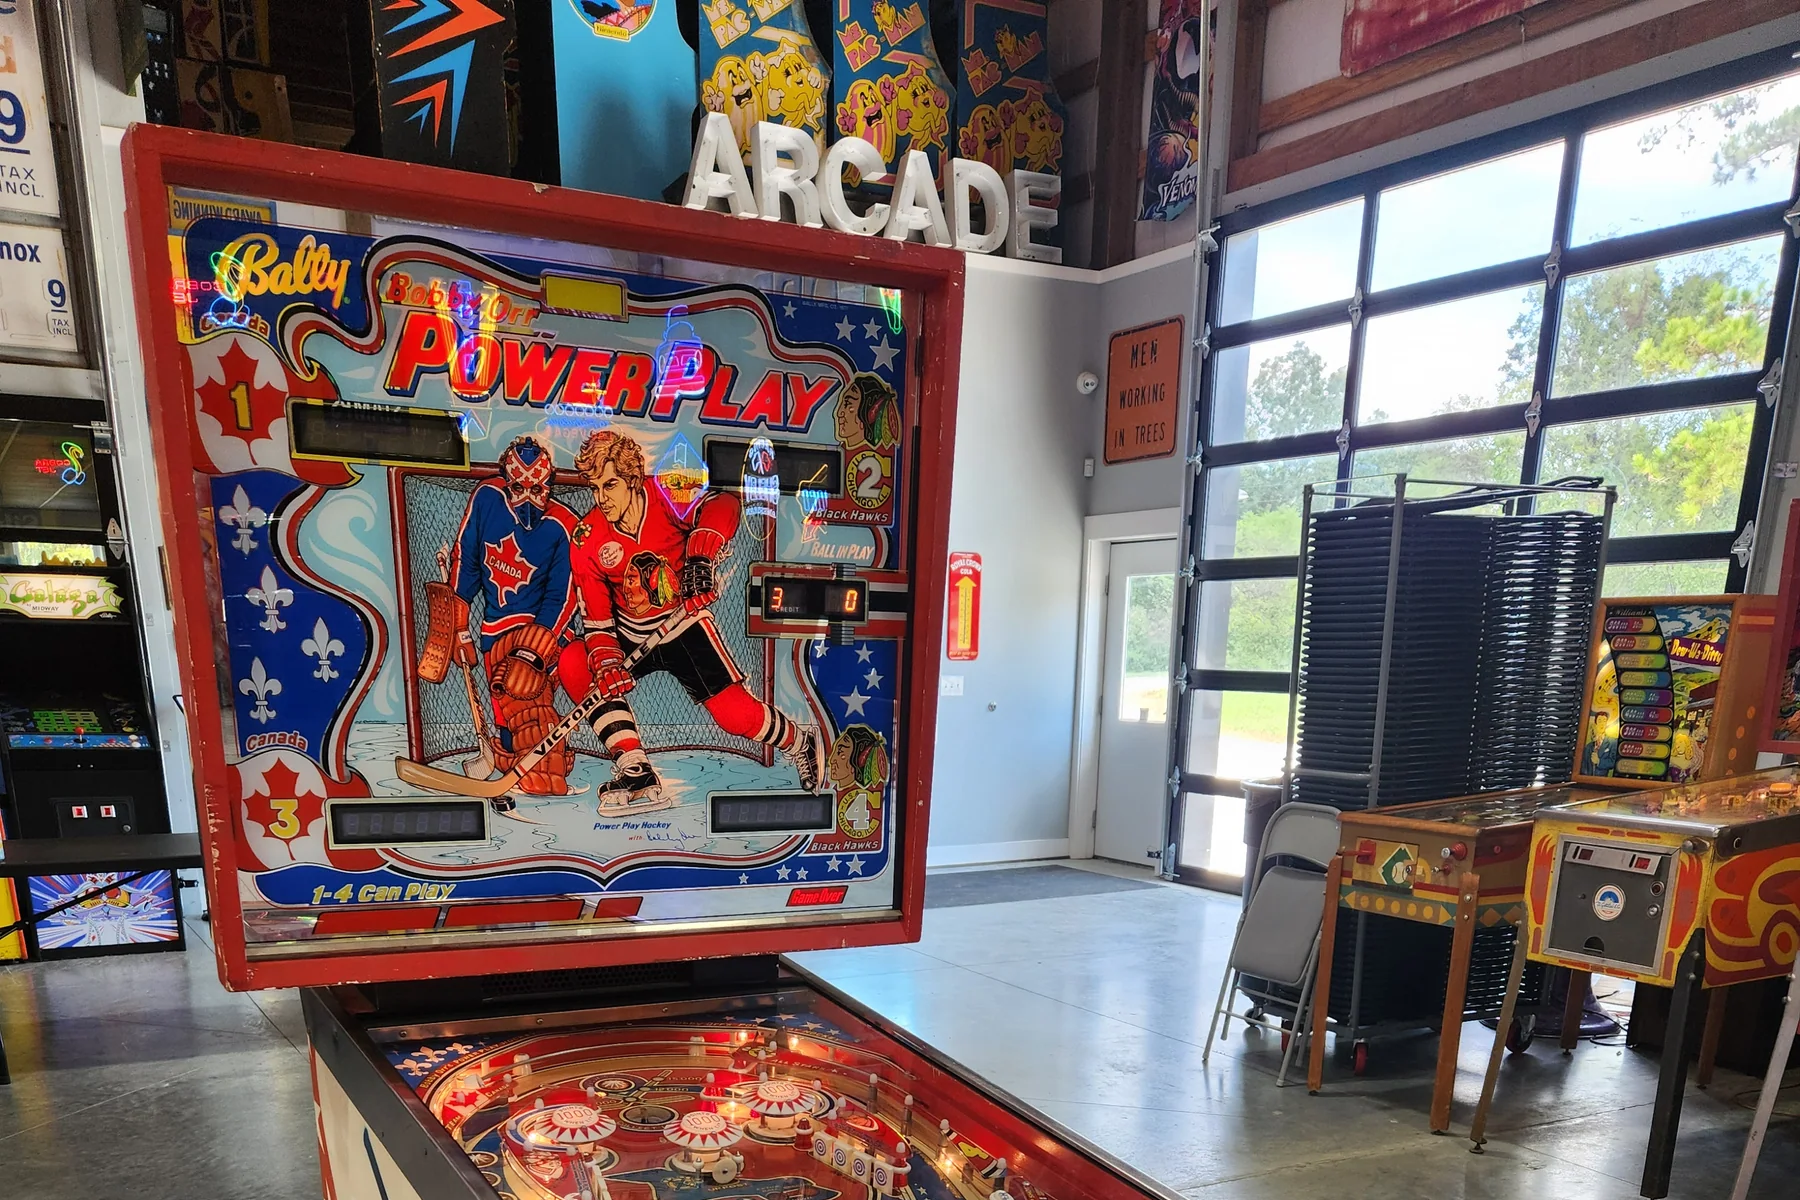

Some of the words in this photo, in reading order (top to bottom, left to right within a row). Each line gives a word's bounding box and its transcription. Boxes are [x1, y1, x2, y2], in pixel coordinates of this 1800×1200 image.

[682, 112, 1063, 265] ARCADE
[215, 232, 351, 310] Bally
[48, 279, 66, 308] 9
[385, 271, 483, 318] Bobby
[486, 290, 538, 327] Orr
[52, 318, 70, 327] TAX
[200, 311, 270, 338] Canada
[1130, 338, 1158, 369] MEN
[383, 309, 656, 415] POWER
[651, 340, 841, 432] PLAY
[229, 381, 254, 431] 1
[1119, 382, 1166, 410] WORKING
[1114, 427, 1125, 448] IN
[1135, 421, 1166, 445] TREES
[857, 456, 882, 499] 2
[815, 508, 848, 520] Black
[850, 510, 889, 522] Hawks
[811, 541, 835, 559] BALL
[836, 542, 848, 559] IN
[848, 543, 875, 560] PLAY
[489, 554, 522, 580] CANADA
[9, 579, 101, 617] Galaga
[771, 587, 783, 609] 3
[845, 589, 858, 611] 0
[246, 731, 309, 752] Canada
[268, 799, 300, 839] 3
[845, 793, 870, 830] 4
[593, 822, 620, 831] Power
[621, 822, 640, 831] Play
[641, 821, 671, 831] Hockey
[811, 841, 841, 852] Black
[842, 839, 879, 850] Hawks
[312, 884, 353, 905] 1-4
[358, 884, 403, 903] Can
[403, 883, 457, 901] Play
[791, 891, 818, 906] Game
[818, 889, 846, 904] Over
[763, 1083, 795, 1095] 1000
[556, 1108, 594, 1120] 1000
[686, 1114, 721, 1126] 1000
